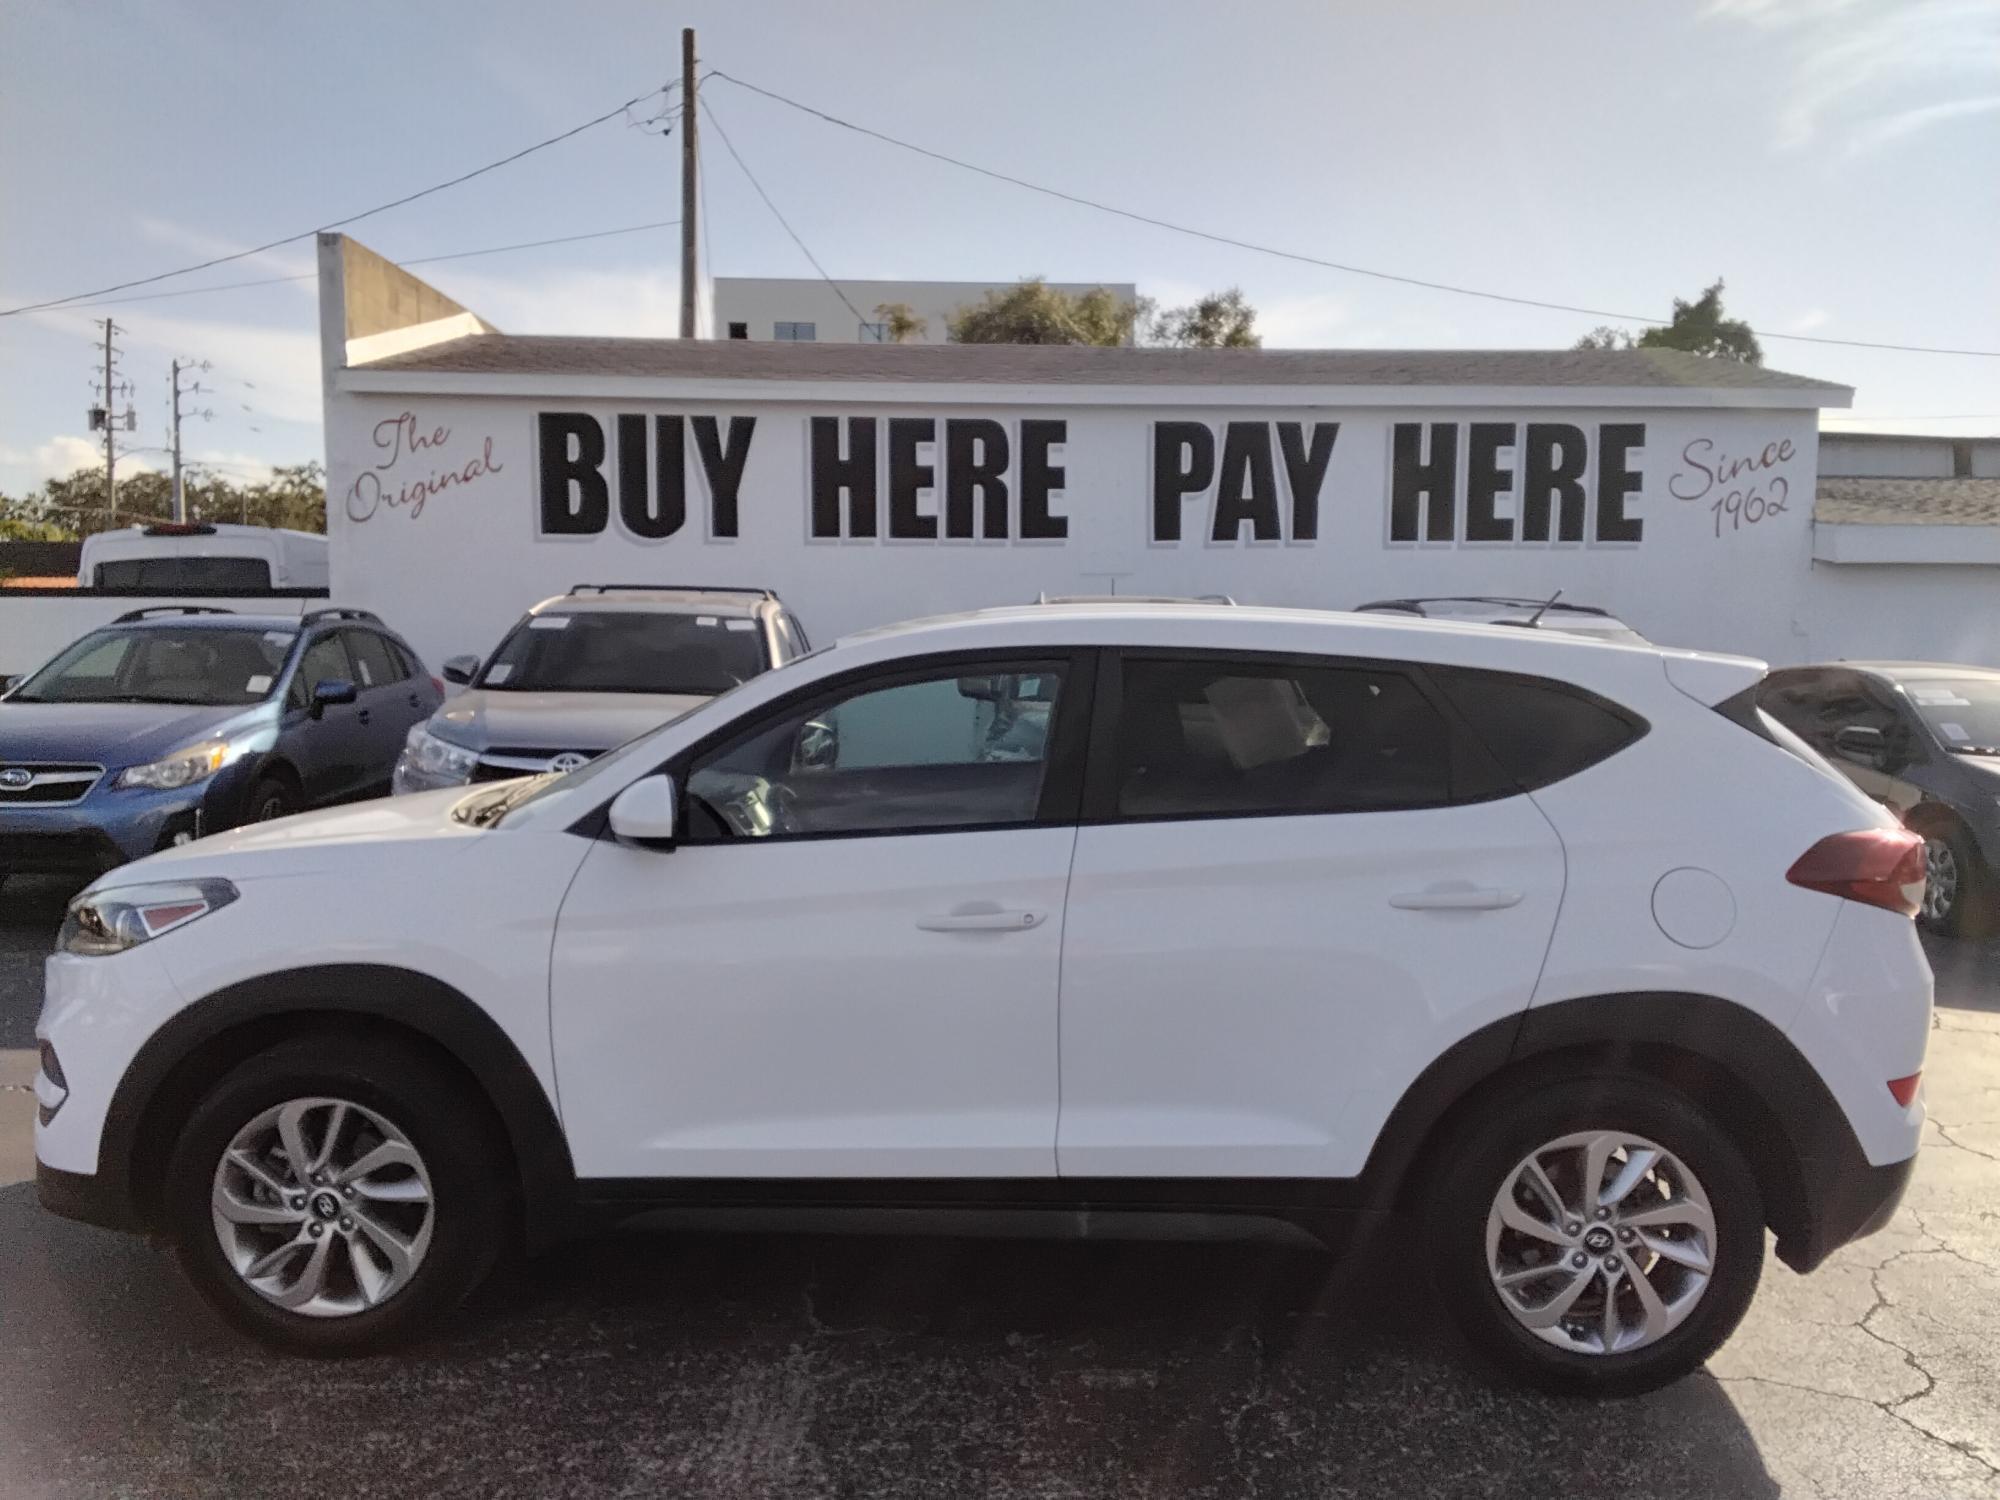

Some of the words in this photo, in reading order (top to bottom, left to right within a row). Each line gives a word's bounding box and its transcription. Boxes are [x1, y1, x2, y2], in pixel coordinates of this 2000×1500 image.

[371, 411, 452, 471] The
[1668, 436, 1797, 501] Since
[344, 436, 506, 524] Original
[537, 411, 758, 539] BUY
[809, 416, 1069, 540] HERE
[1152, 420, 1341, 543] PAY
[1391, 421, 1647, 543] HERE
[1711, 476, 1790, 538] 1962
